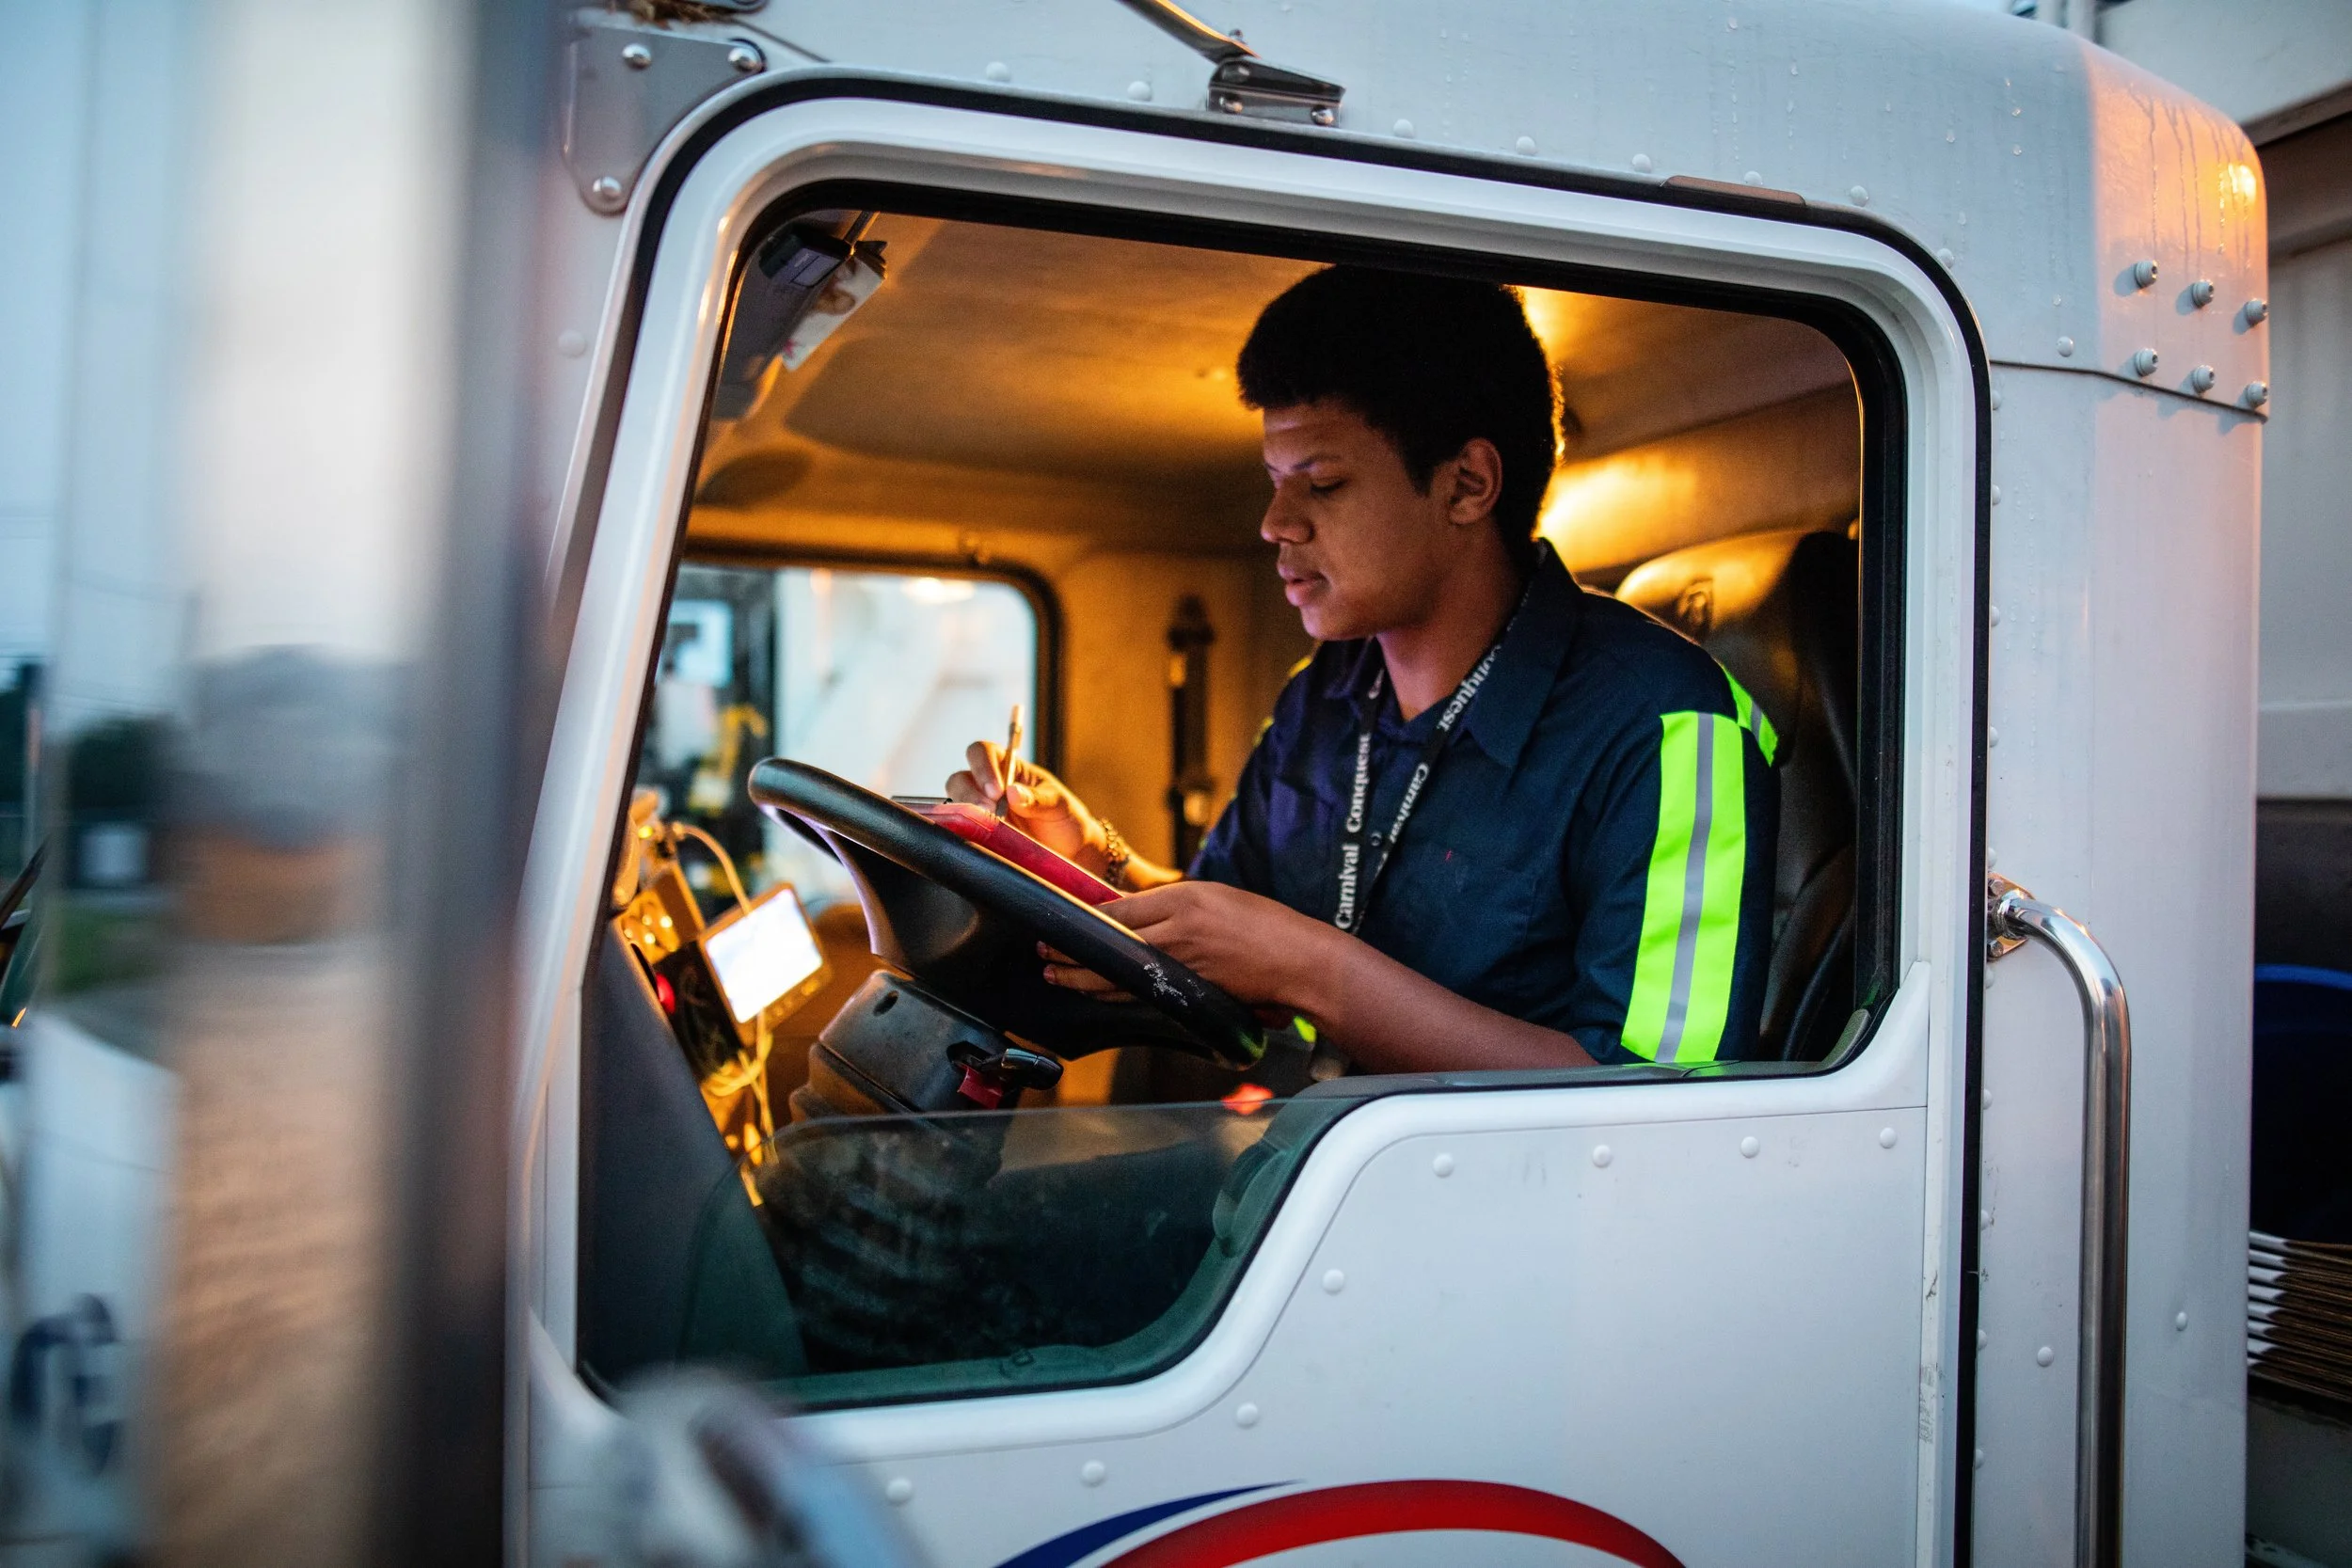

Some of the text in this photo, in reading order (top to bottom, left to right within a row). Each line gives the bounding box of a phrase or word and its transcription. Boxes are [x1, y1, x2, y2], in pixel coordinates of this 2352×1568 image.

[1346, 733, 1372, 833] Conquest
[1390, 763, 1429, 844] Carnival
[1335, 844, 1359, 929] Carnival
